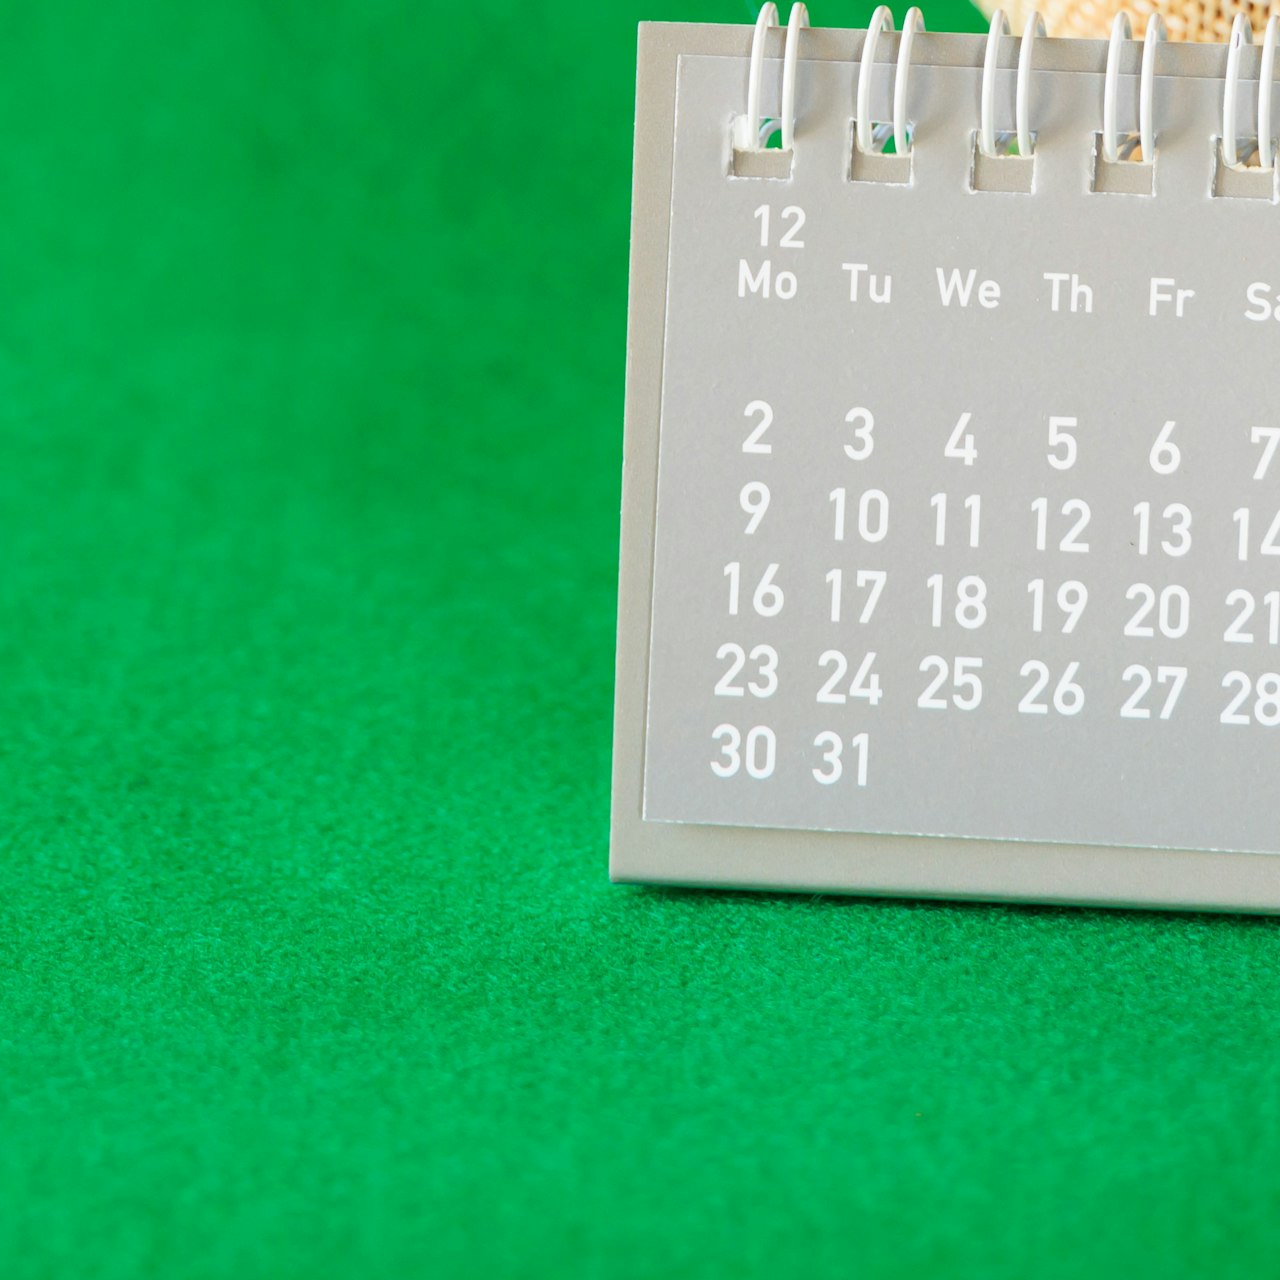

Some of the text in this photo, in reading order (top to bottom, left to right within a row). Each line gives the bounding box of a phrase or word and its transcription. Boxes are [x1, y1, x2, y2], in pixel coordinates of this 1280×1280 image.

[754, 205, 805, 248] 12
[738, 259, 797, 299] Mo
[842, 263, 891, 303] Tu
[936, 268, 1000, 308] We
[1044, 273, 1092, 312] Th
[1150, 278, 1195, 317] Fr
[742, 400, 773, 453] 2
[844, 407, 874, 460] 3
[945, 413, 977, 465] 4
[1048, 416, 1077, 470] 5
[1150, 421, 1181, 474] 6
[1251, 427, 1280, 479] 7
[740, 482, 770, 534] 9
[830, 488, 889, 542] 10
[931, 493, 980, 547] 11
[1032, 498, 1091, 552] 12
[1134, 502, 1192, 556] 13
[724, 562, 784, 617] 16
[826, 569, 887, 623] 17
[927, 574, 987, 629] 18
[1028, 579, 1088, 633] 19
[1124, 583, 1190, 638] 20
[1224, 589, 1280, 644] 21
[715, 643, 778, 697] 23
[816, 650, 882, 705] 24
[918, 655, 982, 710] 25
[1018, 660, 1084, 715] 26
[1120, 664, 1187, 719] 27
[711, 724, 868, 785] 30 31
